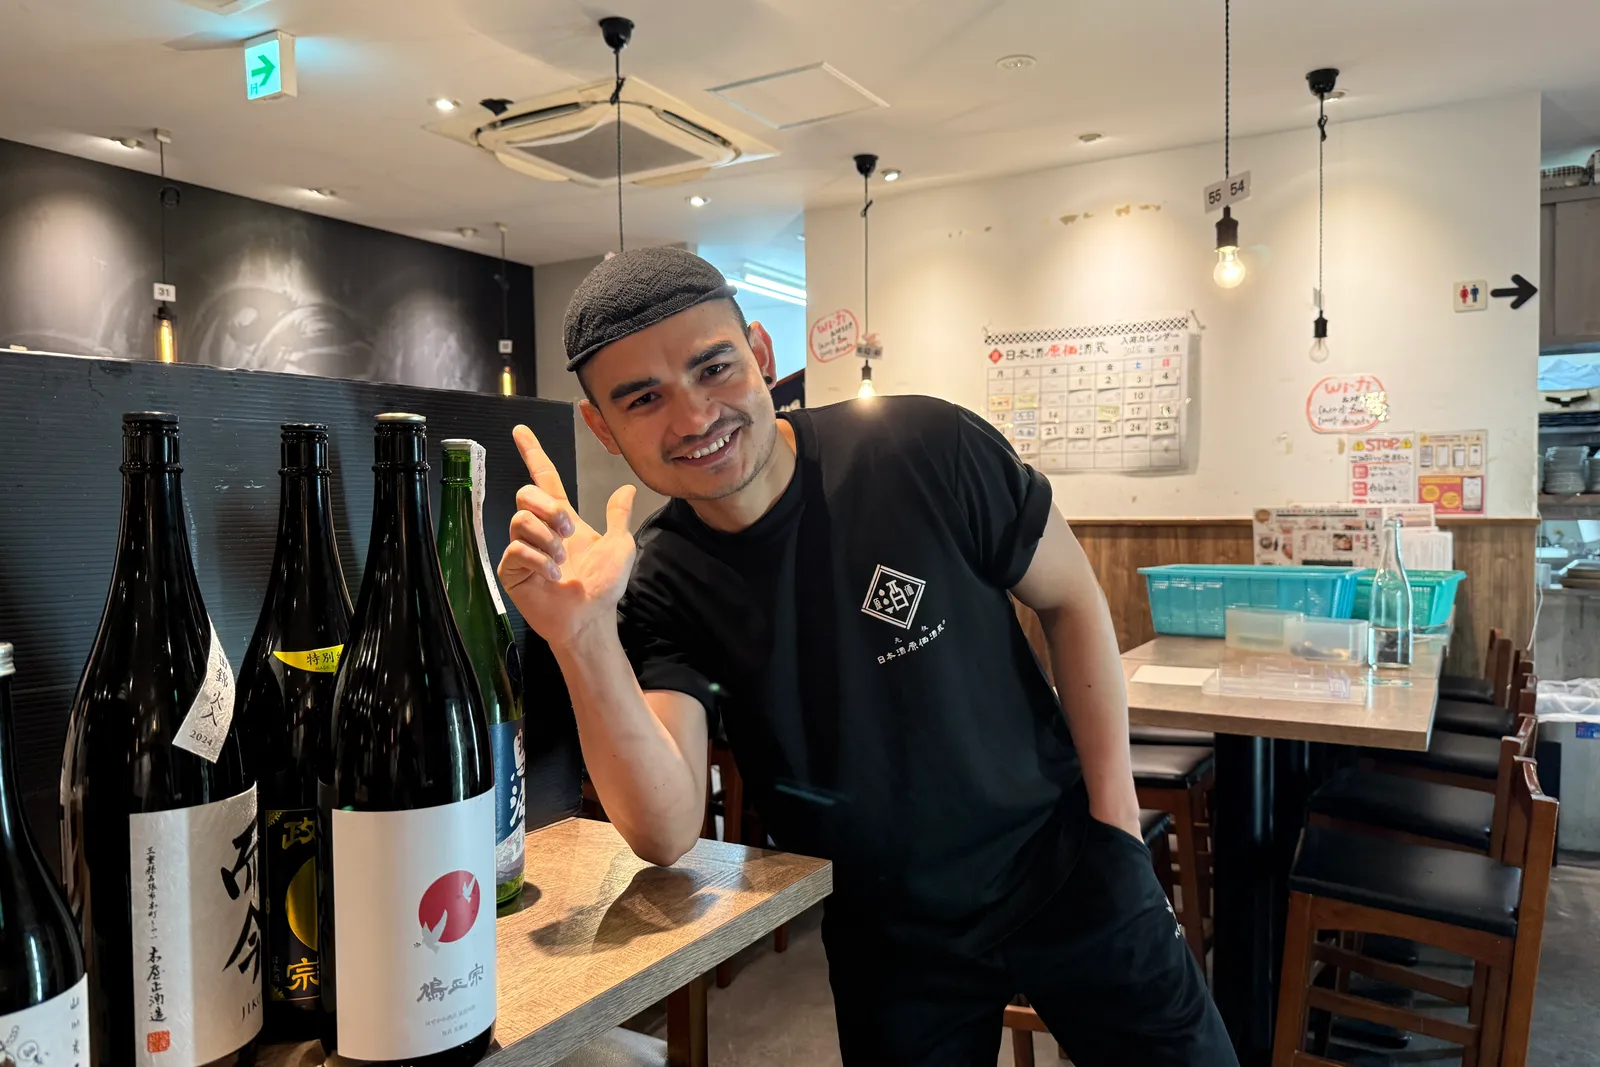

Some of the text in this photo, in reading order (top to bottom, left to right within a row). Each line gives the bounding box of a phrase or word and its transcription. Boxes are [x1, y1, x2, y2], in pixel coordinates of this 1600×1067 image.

[1208, 179, 1245, 205] 55 54
[1155, 421, 1169, 430] 25
[189, 729, 213, 747] 2024
